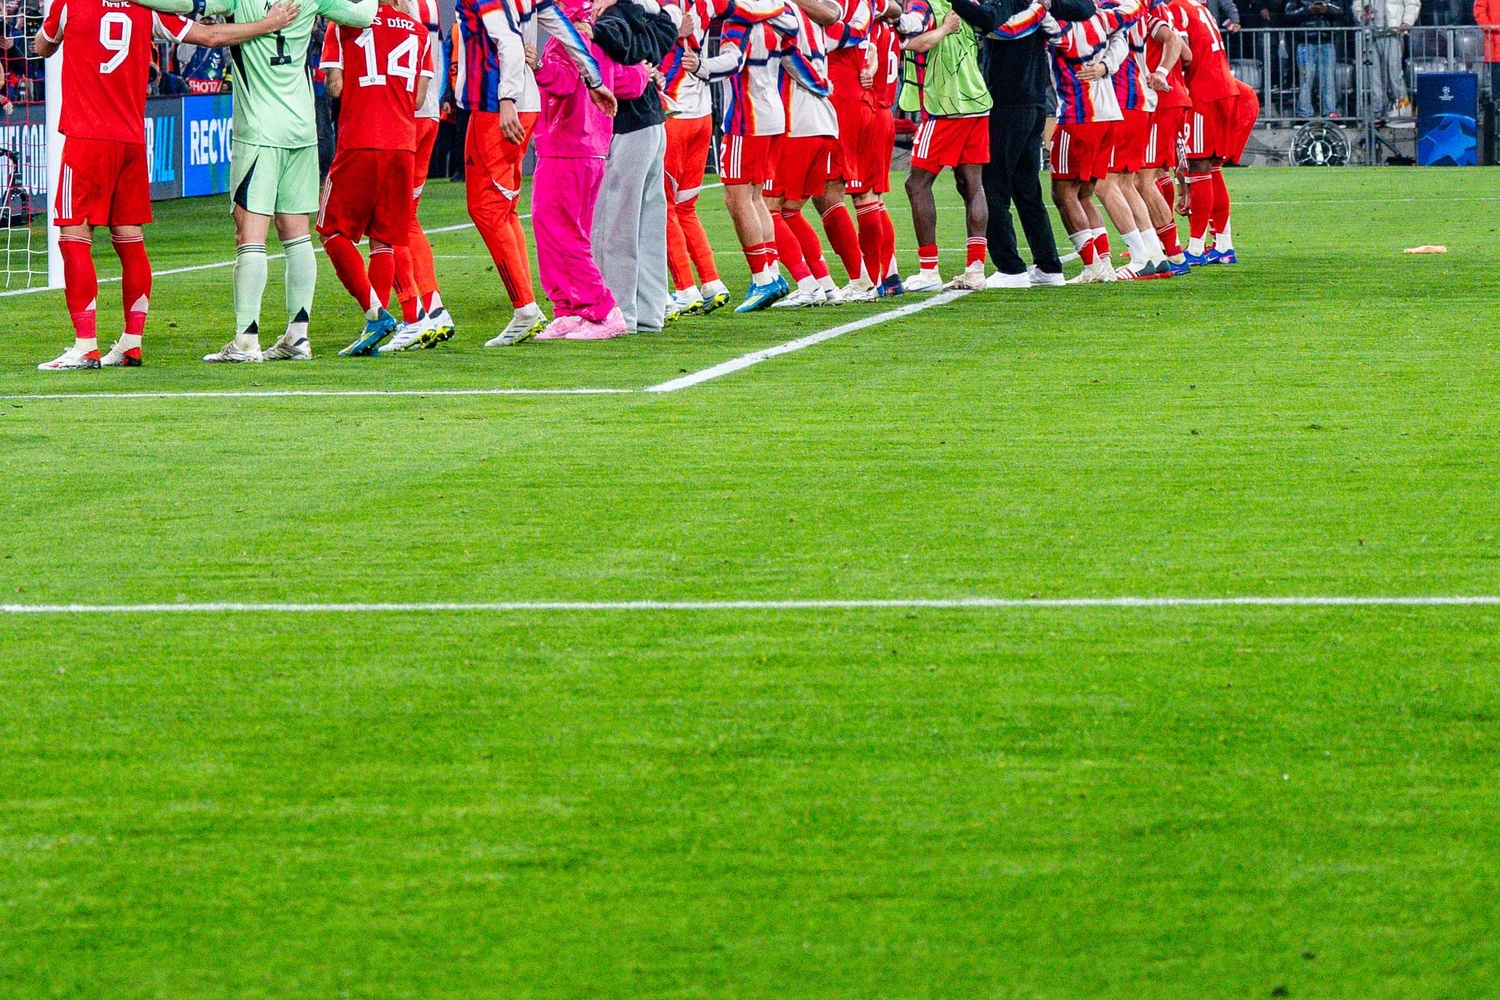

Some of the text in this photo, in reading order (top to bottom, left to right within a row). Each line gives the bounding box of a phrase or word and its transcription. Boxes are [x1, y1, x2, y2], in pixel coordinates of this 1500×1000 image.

[100, 11, 132, 74] 9
[387, 16, 416, 32] DÍAZ
[354, 27, 419, 93] 14
